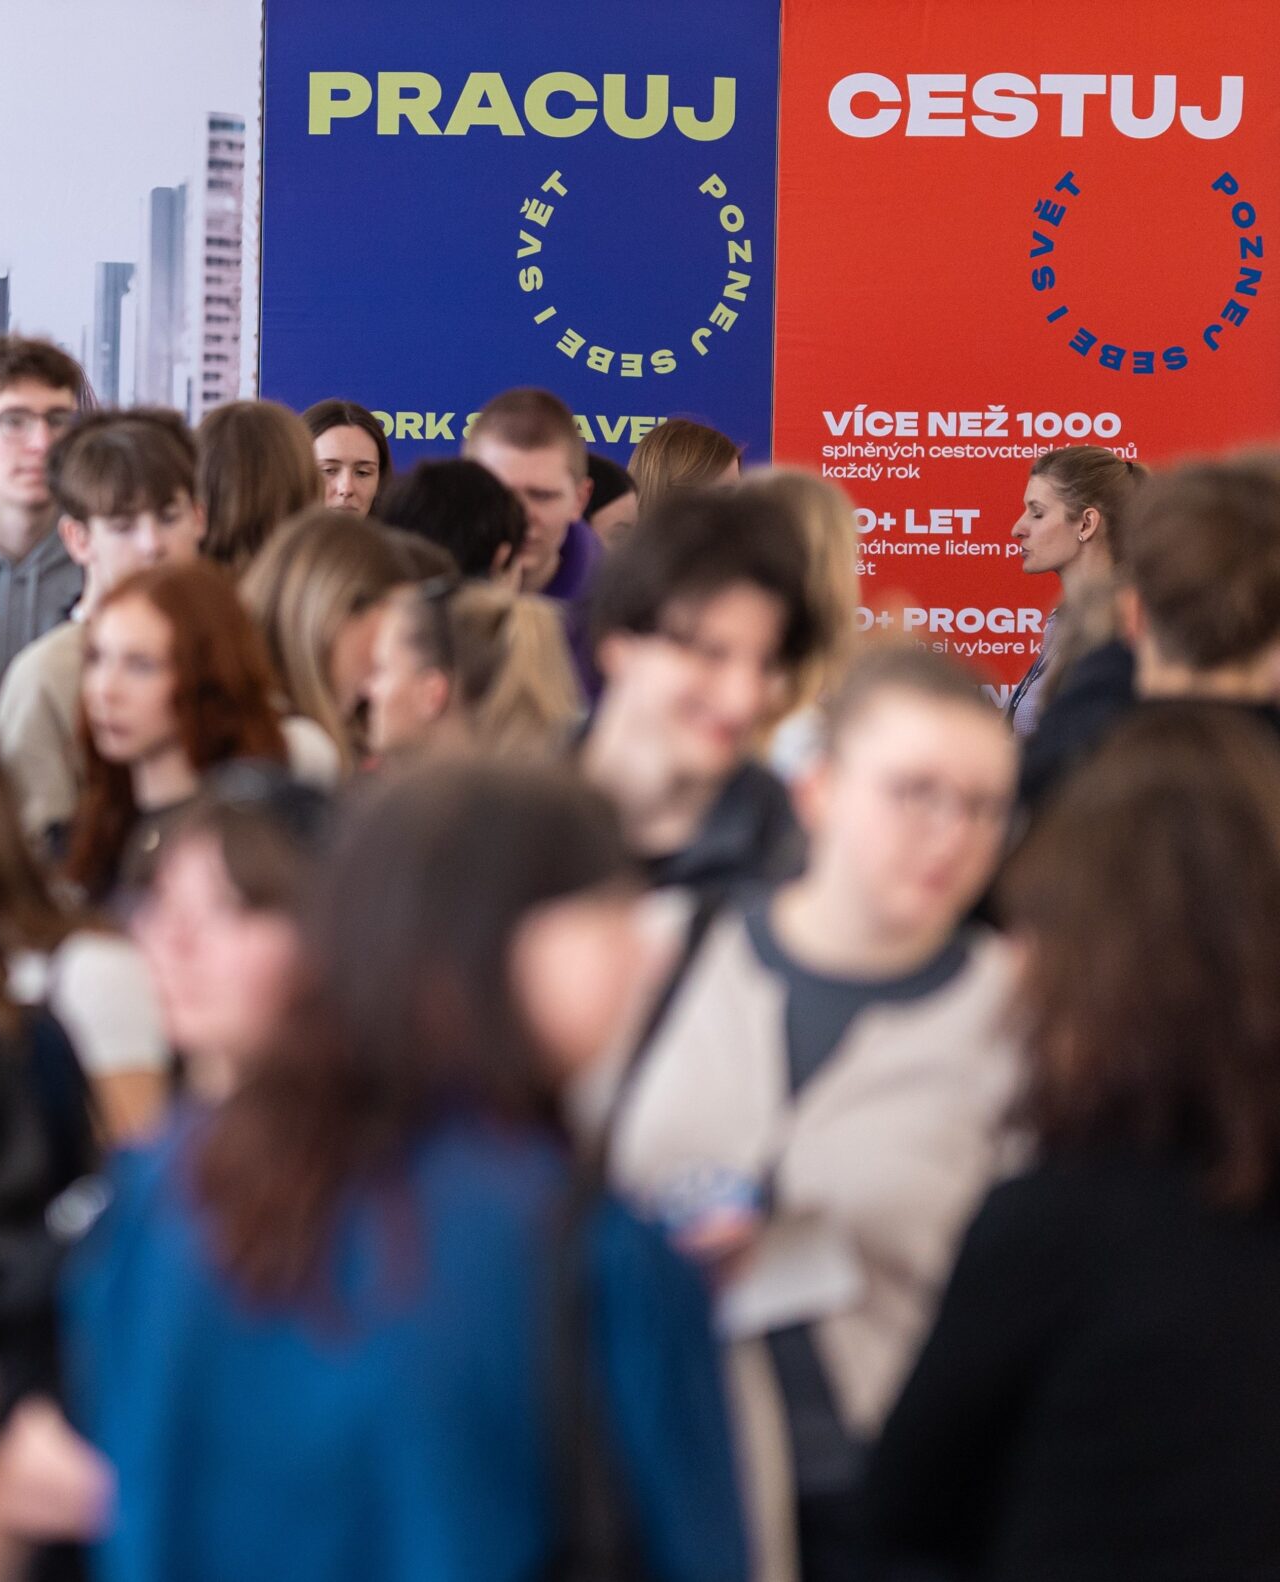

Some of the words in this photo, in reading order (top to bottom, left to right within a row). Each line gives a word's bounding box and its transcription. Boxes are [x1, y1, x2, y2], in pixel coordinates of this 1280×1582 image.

[308, 71, 736, 141] PRACUJ
[828, 72, 1244, 140] CESTUJ
[517, 170, 568, 292] SVĚT
[1029, 170, 1080, 292] SVĚT
[691, 173, 752, 355] POZNEJ
[1202, 171, 1263, 351] POZNEJ
[533, 306, 557, 324] I
[1046, 305, 1069, 323] I
[556, 328, 677, 377] SEBE
[1068, 327, 1188, 374] SEBE
[370, 410, 456, 440] ORK
[570, 415, 668, 443] AVE
[822, 404, 919, 437] VÍCE
[928, 405, 1008, 437] NEŽ
[1017, 412, 1121, 438] 1000
[822, 442, 925, 461] splněných
[1104, 442, 1137, 459] nů
[822, 463, 883, 481] každý
[887, 463, 920, 479] rok
[852, 508, 896, 533] 0+
[905, 509, 980, 534] LET
[855, 539, 940, 555] máhame
[945, 540, 1000, 555] lidem
[854, 560, 876, 576] ět
[854, 607, 894, 632] 0+
[903, 607, 1053, 633] PROGR
[953, 639, 1024, 657] vybere
